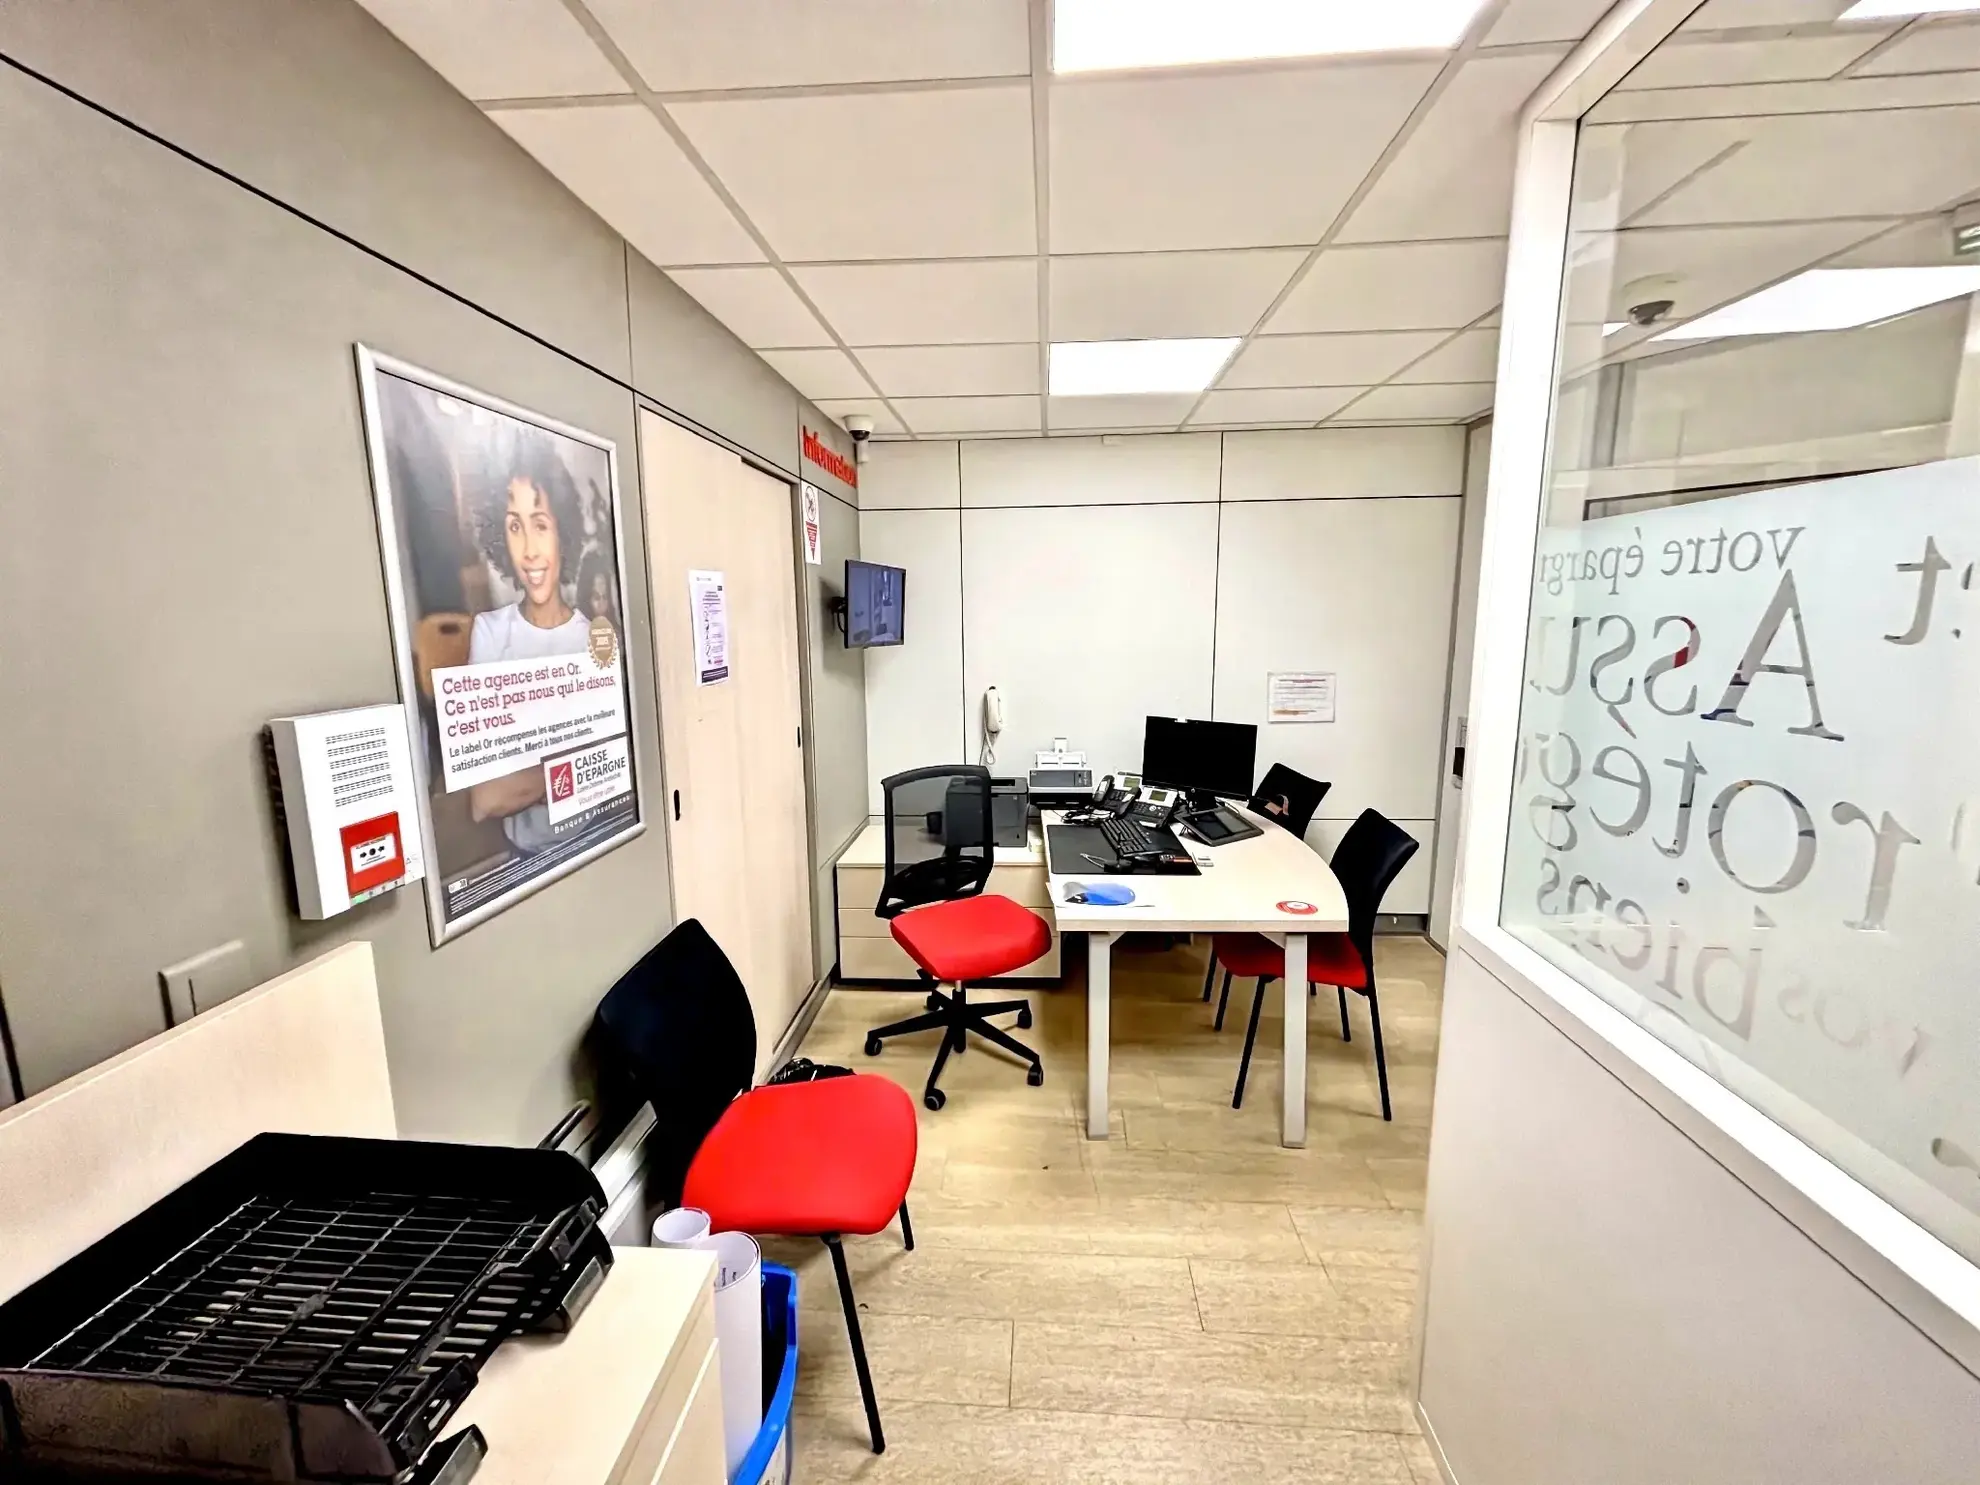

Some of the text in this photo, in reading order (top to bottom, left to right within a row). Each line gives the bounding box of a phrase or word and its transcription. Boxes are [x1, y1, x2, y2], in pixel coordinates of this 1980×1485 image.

[442, 662, 582, 695] Cette agence est en Or.
[445, 699, 466, 716] Ce
[468, 692, 500, 712] n'est
[502, 690, 526, 709] pas
[528, 686, 555, 701] nous
[557, 680, 574, 698] qui
[576, 678, 585, 692] le
[447, 713, 516, 737] c'est vous.
[449, 747, 460, 758] Le
[461, 739, 482, 755] label
[483, 738, 493, 749] Or
[495, 728, 537, 746] récompense
[538, 725, 547, 735] les
[548, 720, 573, 733] agences
[574, 717, 587, 726] avec
[587, 714, 593, 722] la
[451, 754, 498, 773] satisfaction
[498, 746, 524, 760] clients.
[525, 740, 543, 752] Merci
[550, 735, 563, 745] tous
[575, 749, 608, 770] CAISSE
[577, 757, 626, 784] D'EPARGNE
[554, 817, 583, 834] Banque
[592, 796, 630, 817] Assurances
